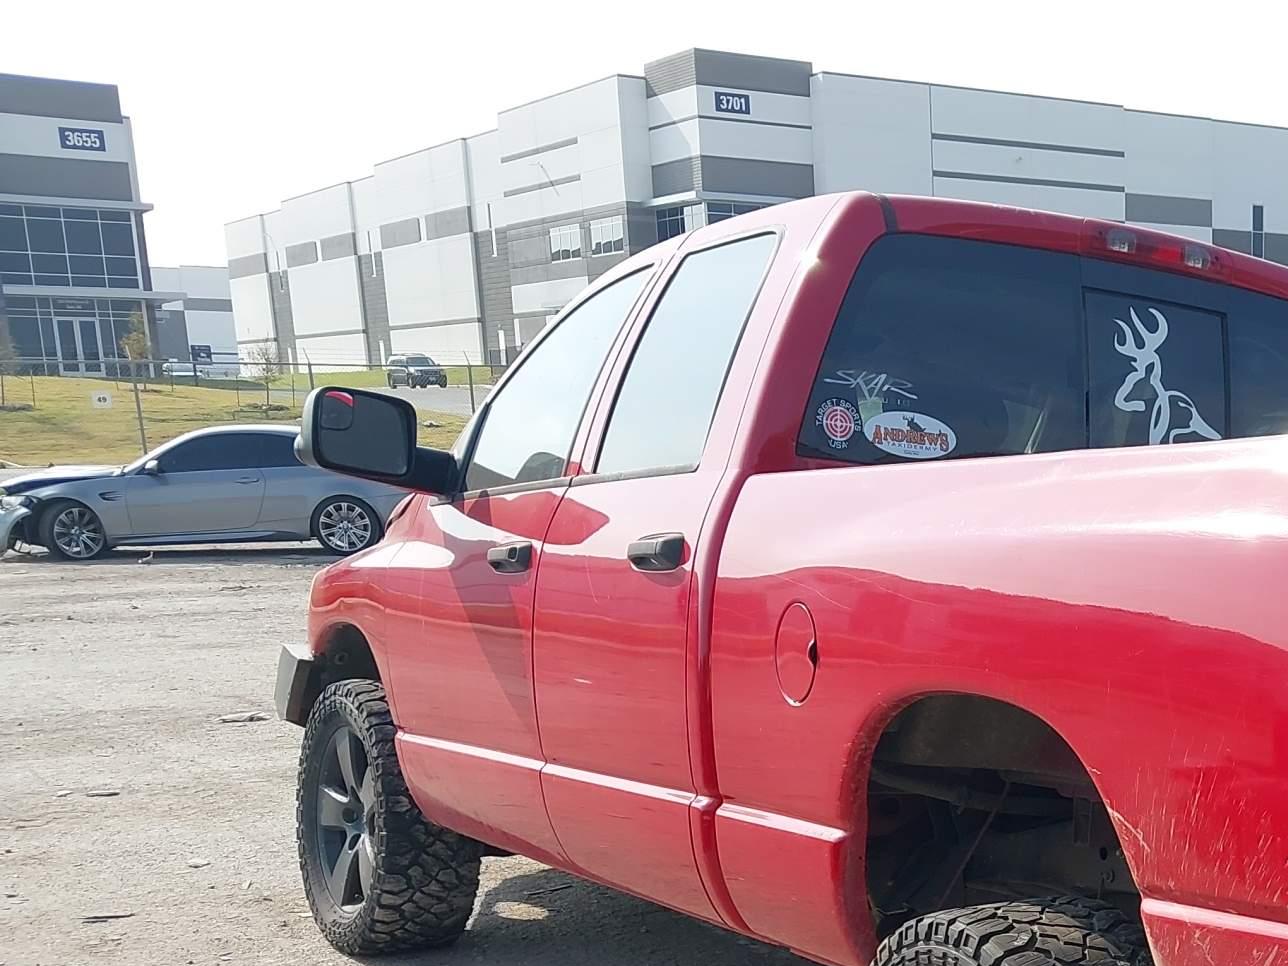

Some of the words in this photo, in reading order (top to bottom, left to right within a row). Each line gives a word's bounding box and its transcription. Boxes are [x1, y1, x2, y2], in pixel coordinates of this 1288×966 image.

[719, 95, 746, 112] 3701
[64, 130, 100, 148] 3655
[824, 370, 918, 400] SKAR
[815, 398, 837, 427] TARGET
[839, 399, 862, 432] SPORTS
[828, 439, 849, 449] USA
[886, 441, 939, 452] TAXIDERMY
